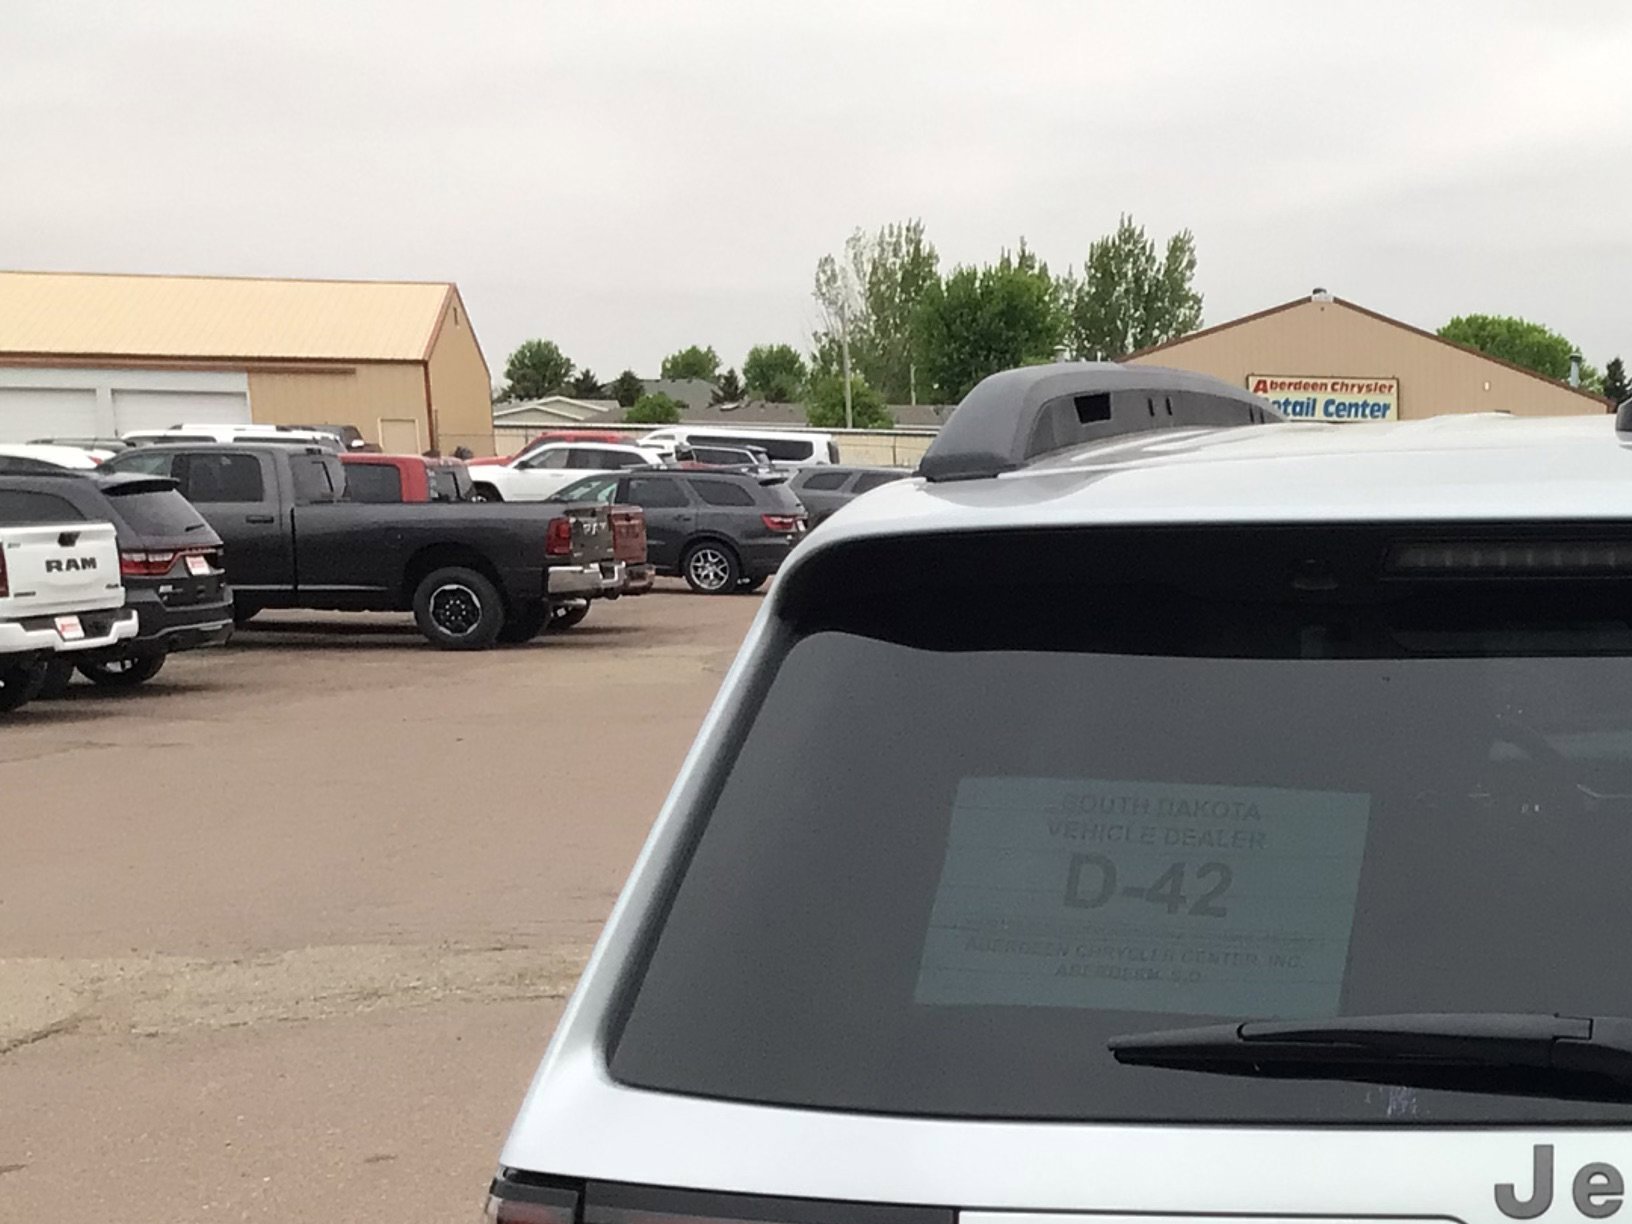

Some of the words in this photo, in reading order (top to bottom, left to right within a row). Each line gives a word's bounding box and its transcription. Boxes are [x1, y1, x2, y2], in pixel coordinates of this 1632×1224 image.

[1253, 379, 1328, 393] Aberdeen
[1331, 381, 1395, 395] Chrysler
[1323, 398, 1391, 419] Center
[45, 557, 98, 573] RAM
[1062, 793, 1150, 816] SOUTH
[1157, 797, 1262, 821] DAKOTA
[1047, 820, 1156, 846] VEHICLE
[1163, 826, 1268, 850] DEALER
[1062, 852, 1234, 918] D-42
